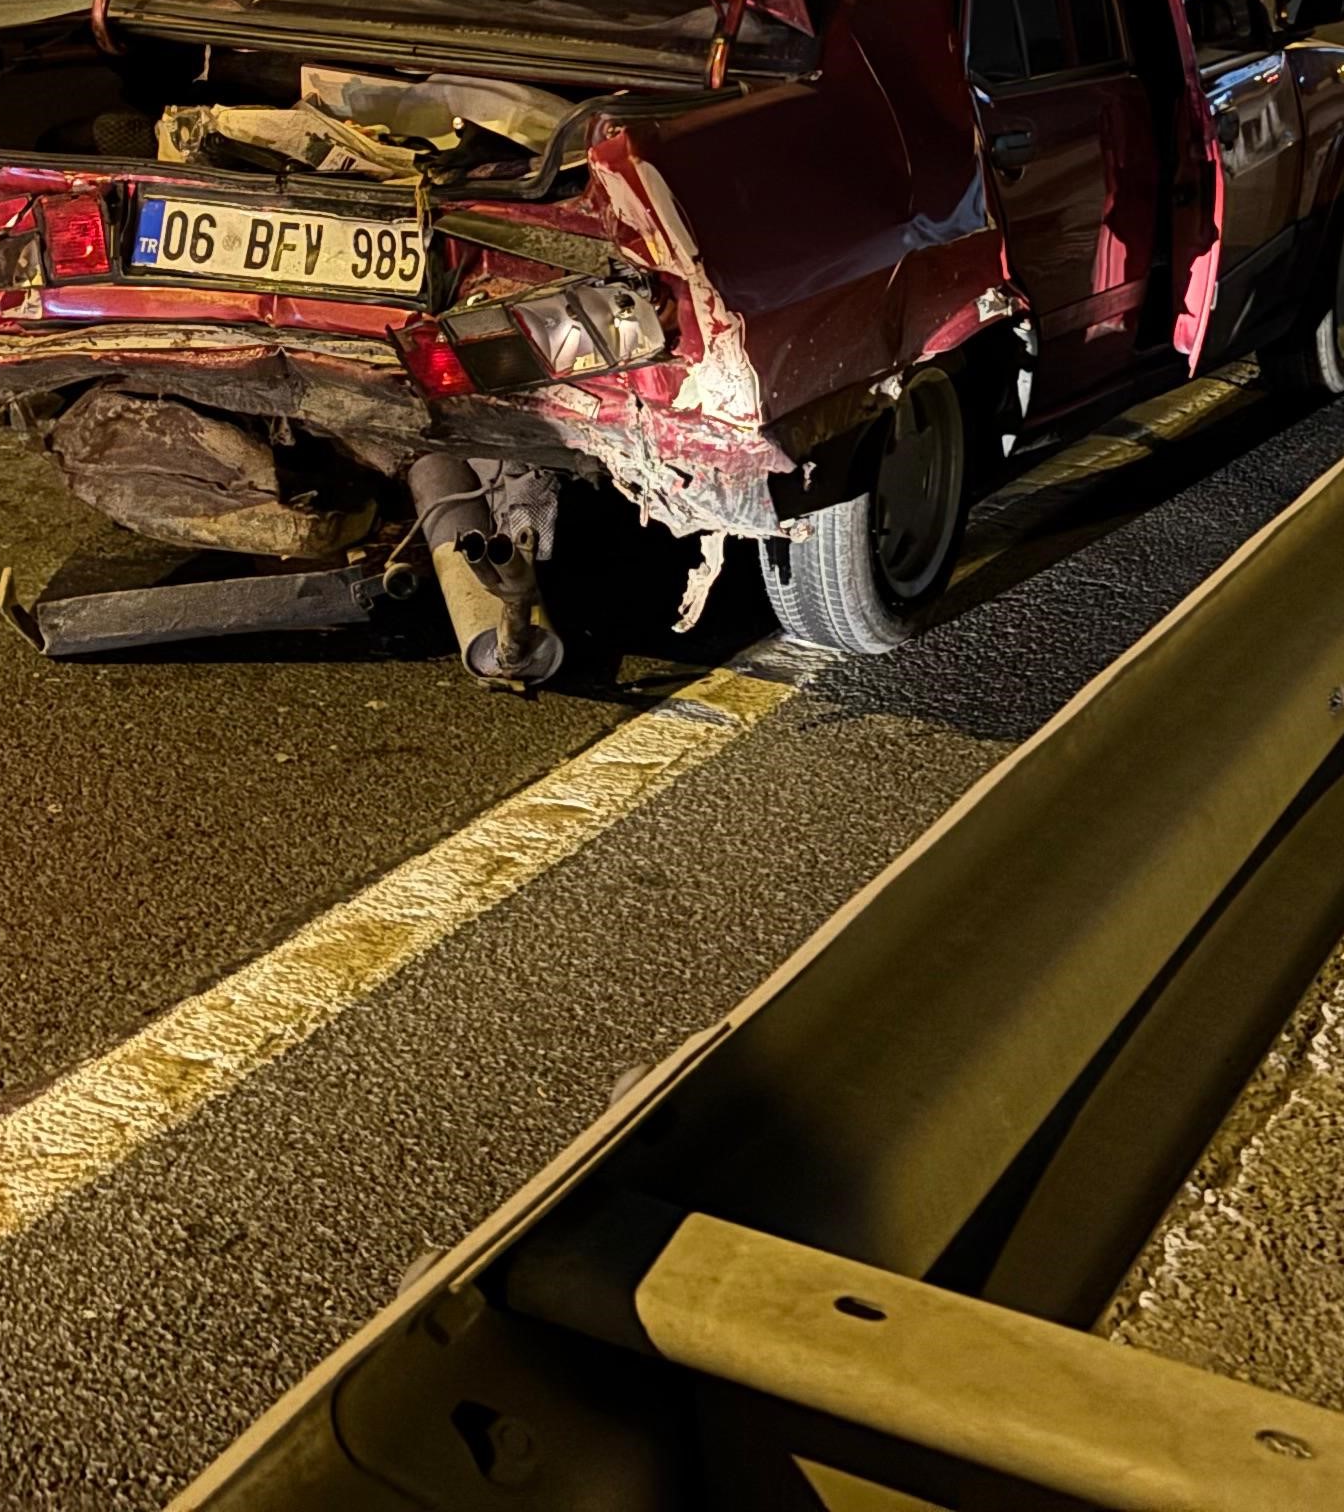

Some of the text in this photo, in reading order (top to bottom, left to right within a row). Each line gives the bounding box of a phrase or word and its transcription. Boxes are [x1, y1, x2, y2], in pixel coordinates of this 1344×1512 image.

[140, 237, 158, 254] TR
[162, 210, 217, 264] 06
[351, 227, 421, 282] 985
